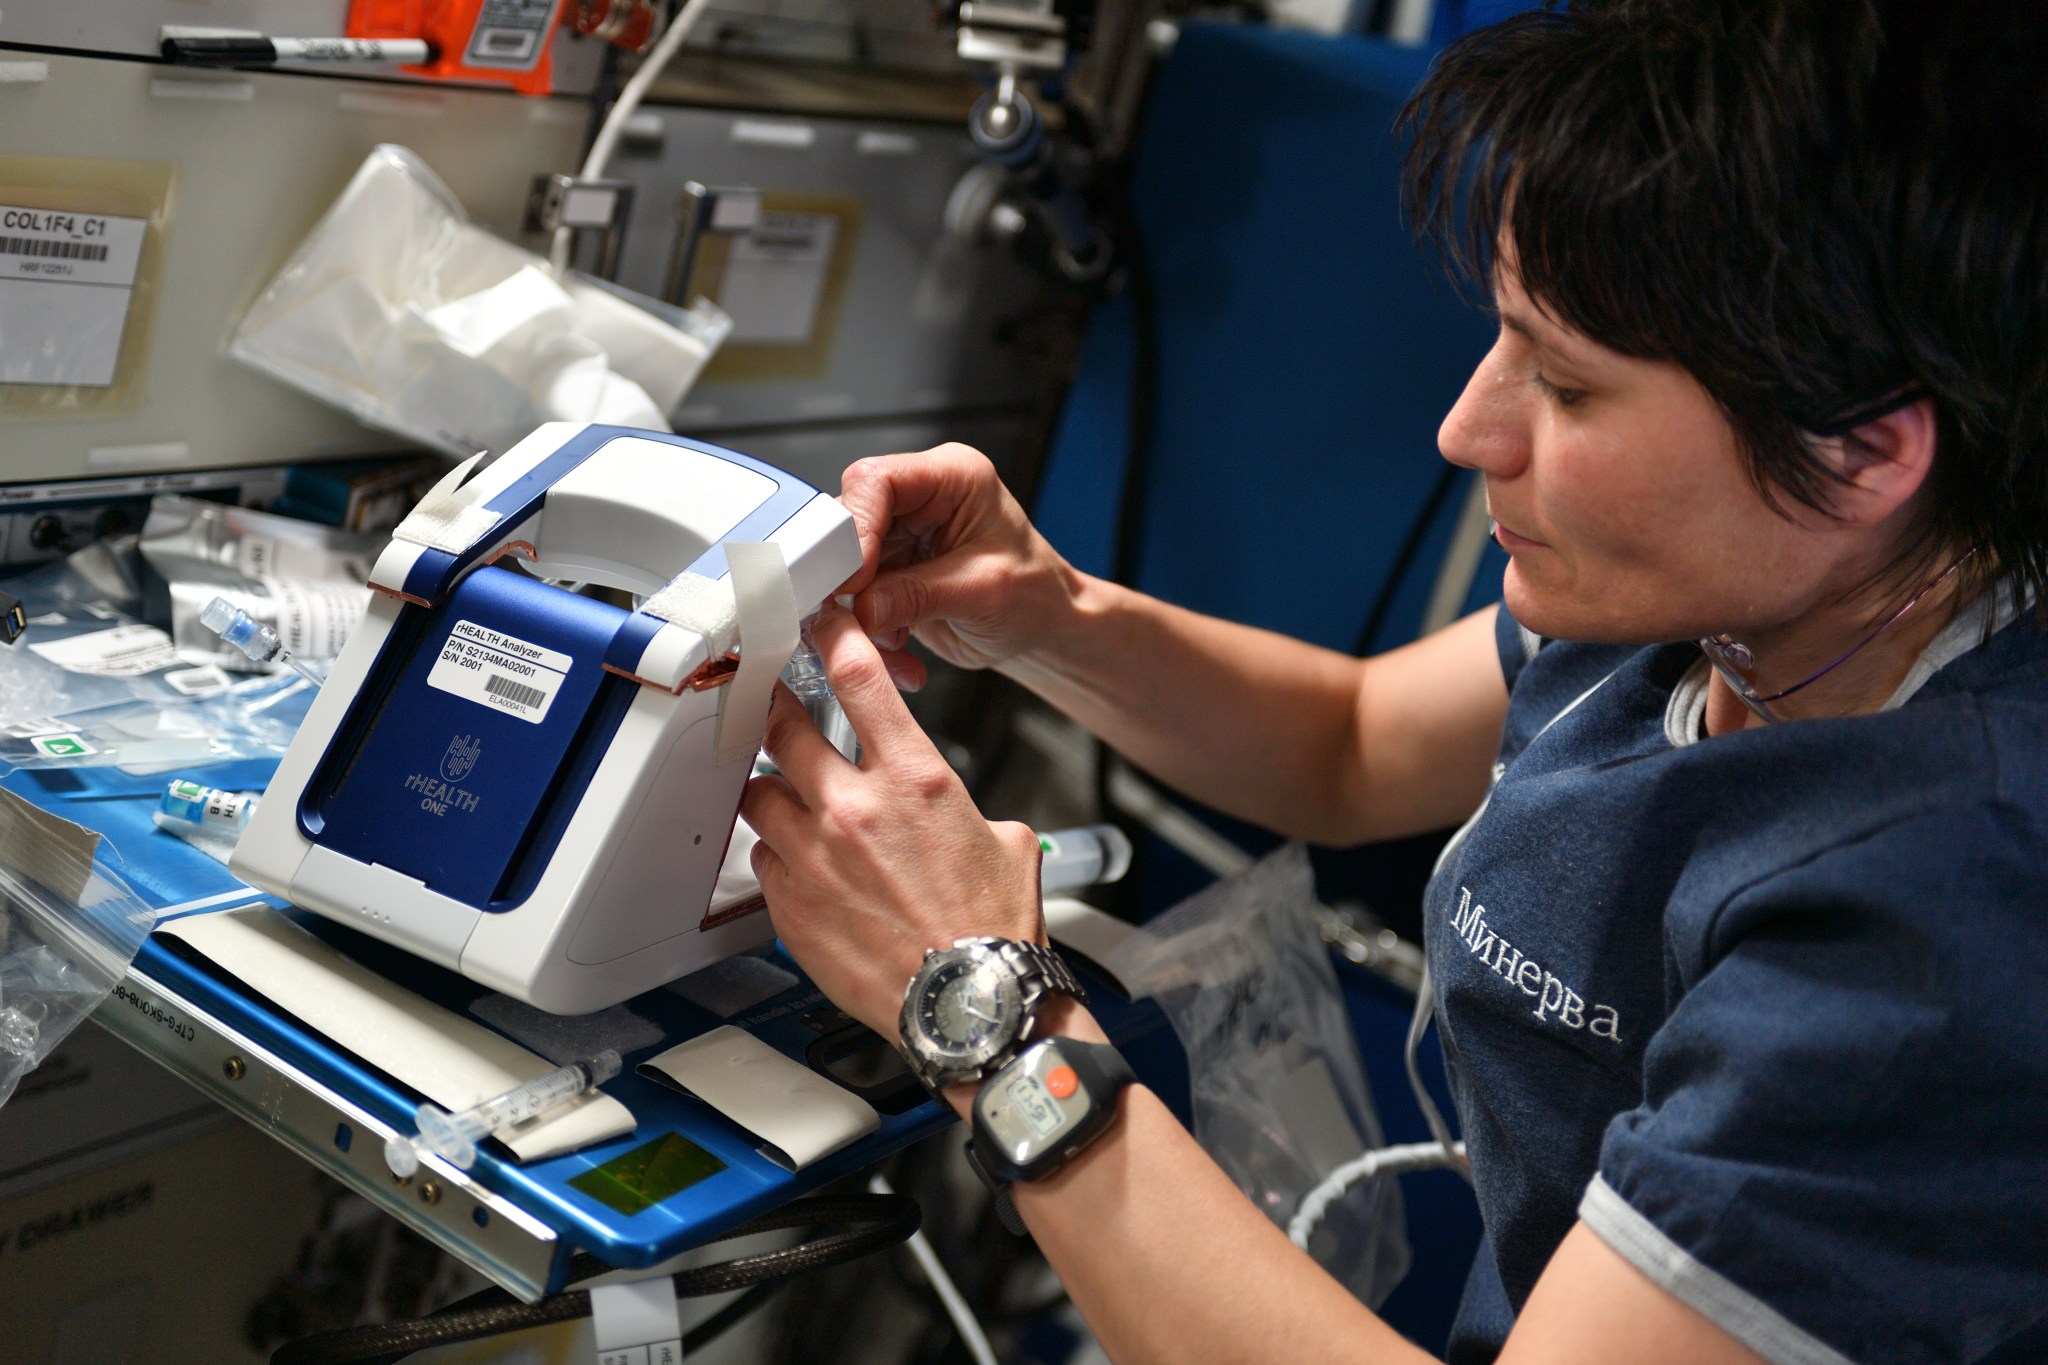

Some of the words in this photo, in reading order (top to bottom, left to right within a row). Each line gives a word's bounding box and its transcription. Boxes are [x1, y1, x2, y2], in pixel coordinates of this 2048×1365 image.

[4, 210, 106, 239] COL1F4_C1
[456, 624, 500, 645] rHEALTH
[500, 639, 543, 660] Analyzer
[442, 650, 460, 663] S/N
[460, 657, 482, 672] 2001
[447, 640, 465, 653] P/N
[466, 646, 536, 678] S2134MA02001
[488, 694, 527, 714] ELA00041L
[404, 773, 480, 813] rHEALTH
[420, 798, 448, 817] ONE
[1450, 886, 1622, 1044] Минерва
